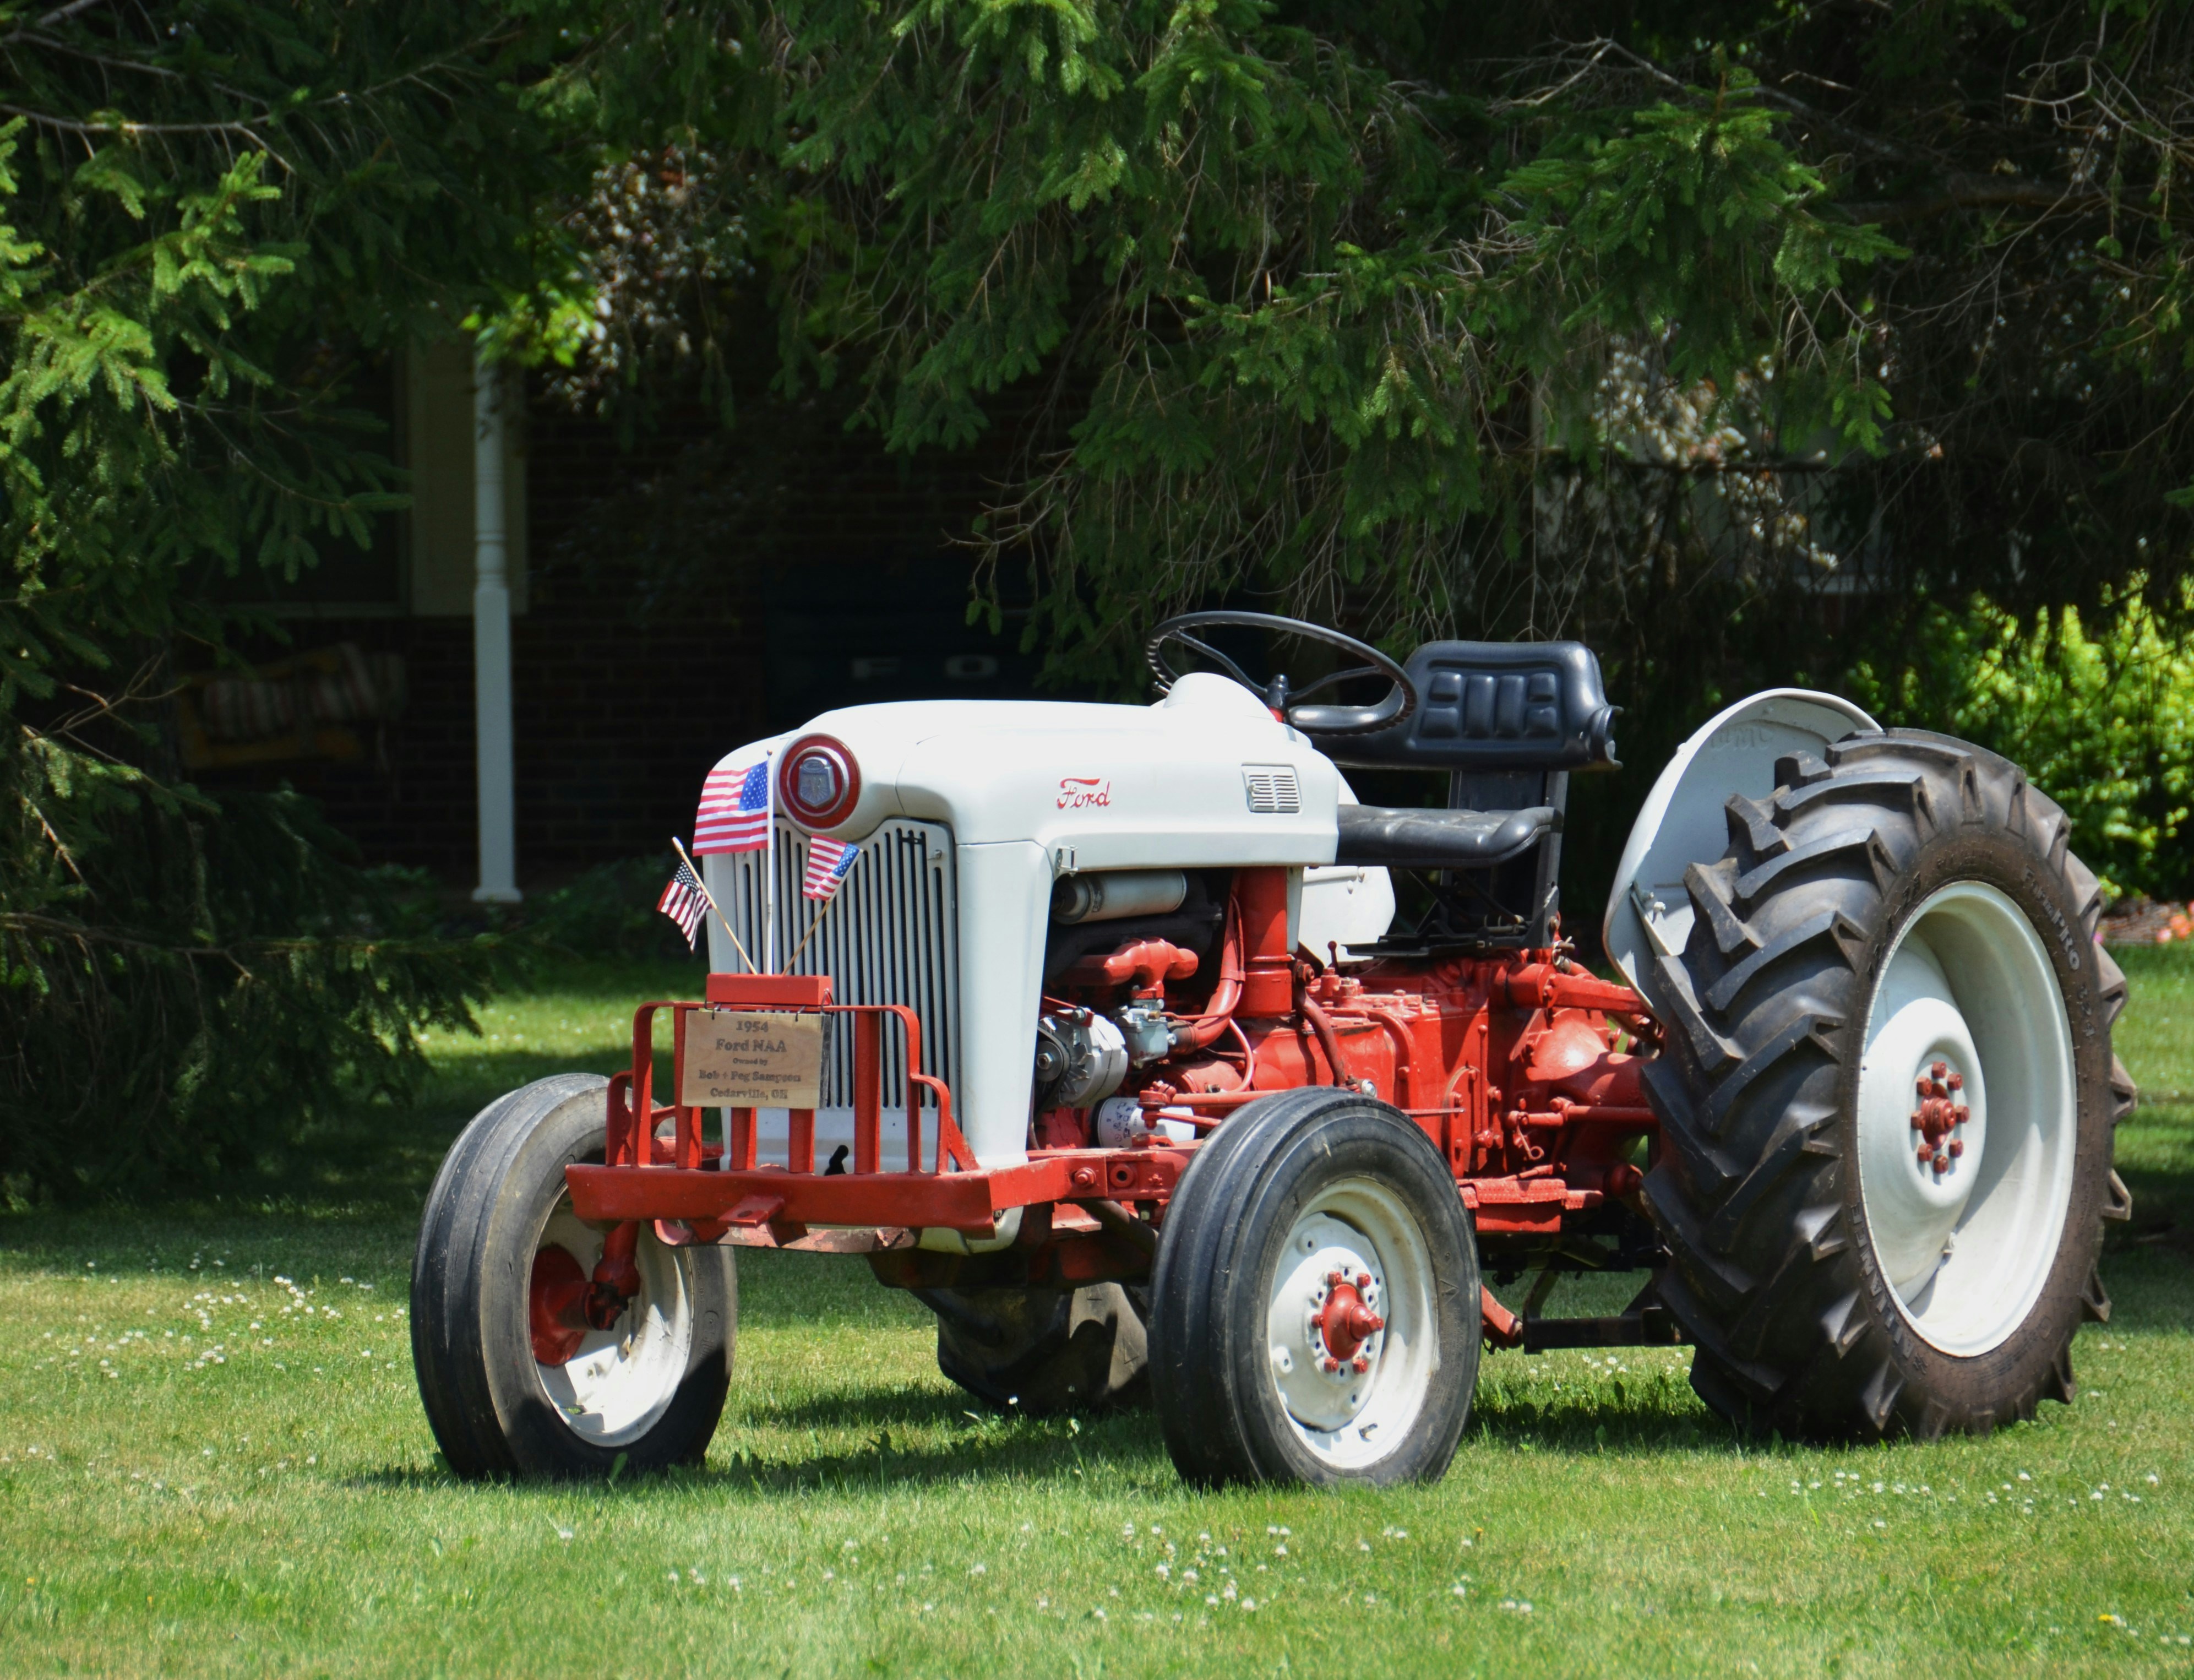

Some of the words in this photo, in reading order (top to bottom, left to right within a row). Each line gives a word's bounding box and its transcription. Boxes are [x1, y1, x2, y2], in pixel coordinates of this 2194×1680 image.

[1056, 778, 1110, 809] Ford
[736, 1020, 769, 1032] 1954
[716, 1039, 749, 1052] Ford
[752, 1039, 787, 1052] NAA
[759, 1058, 769, 1066] by
[699, 1069, 720, 1080] Bob
[731, 1070, 750, 1083] Peg
[752, 1071, 802, 1084] Sampson
[710, 1088, 769, 1101] Cedarville,
[771, 1089, 788, 1099] OH
